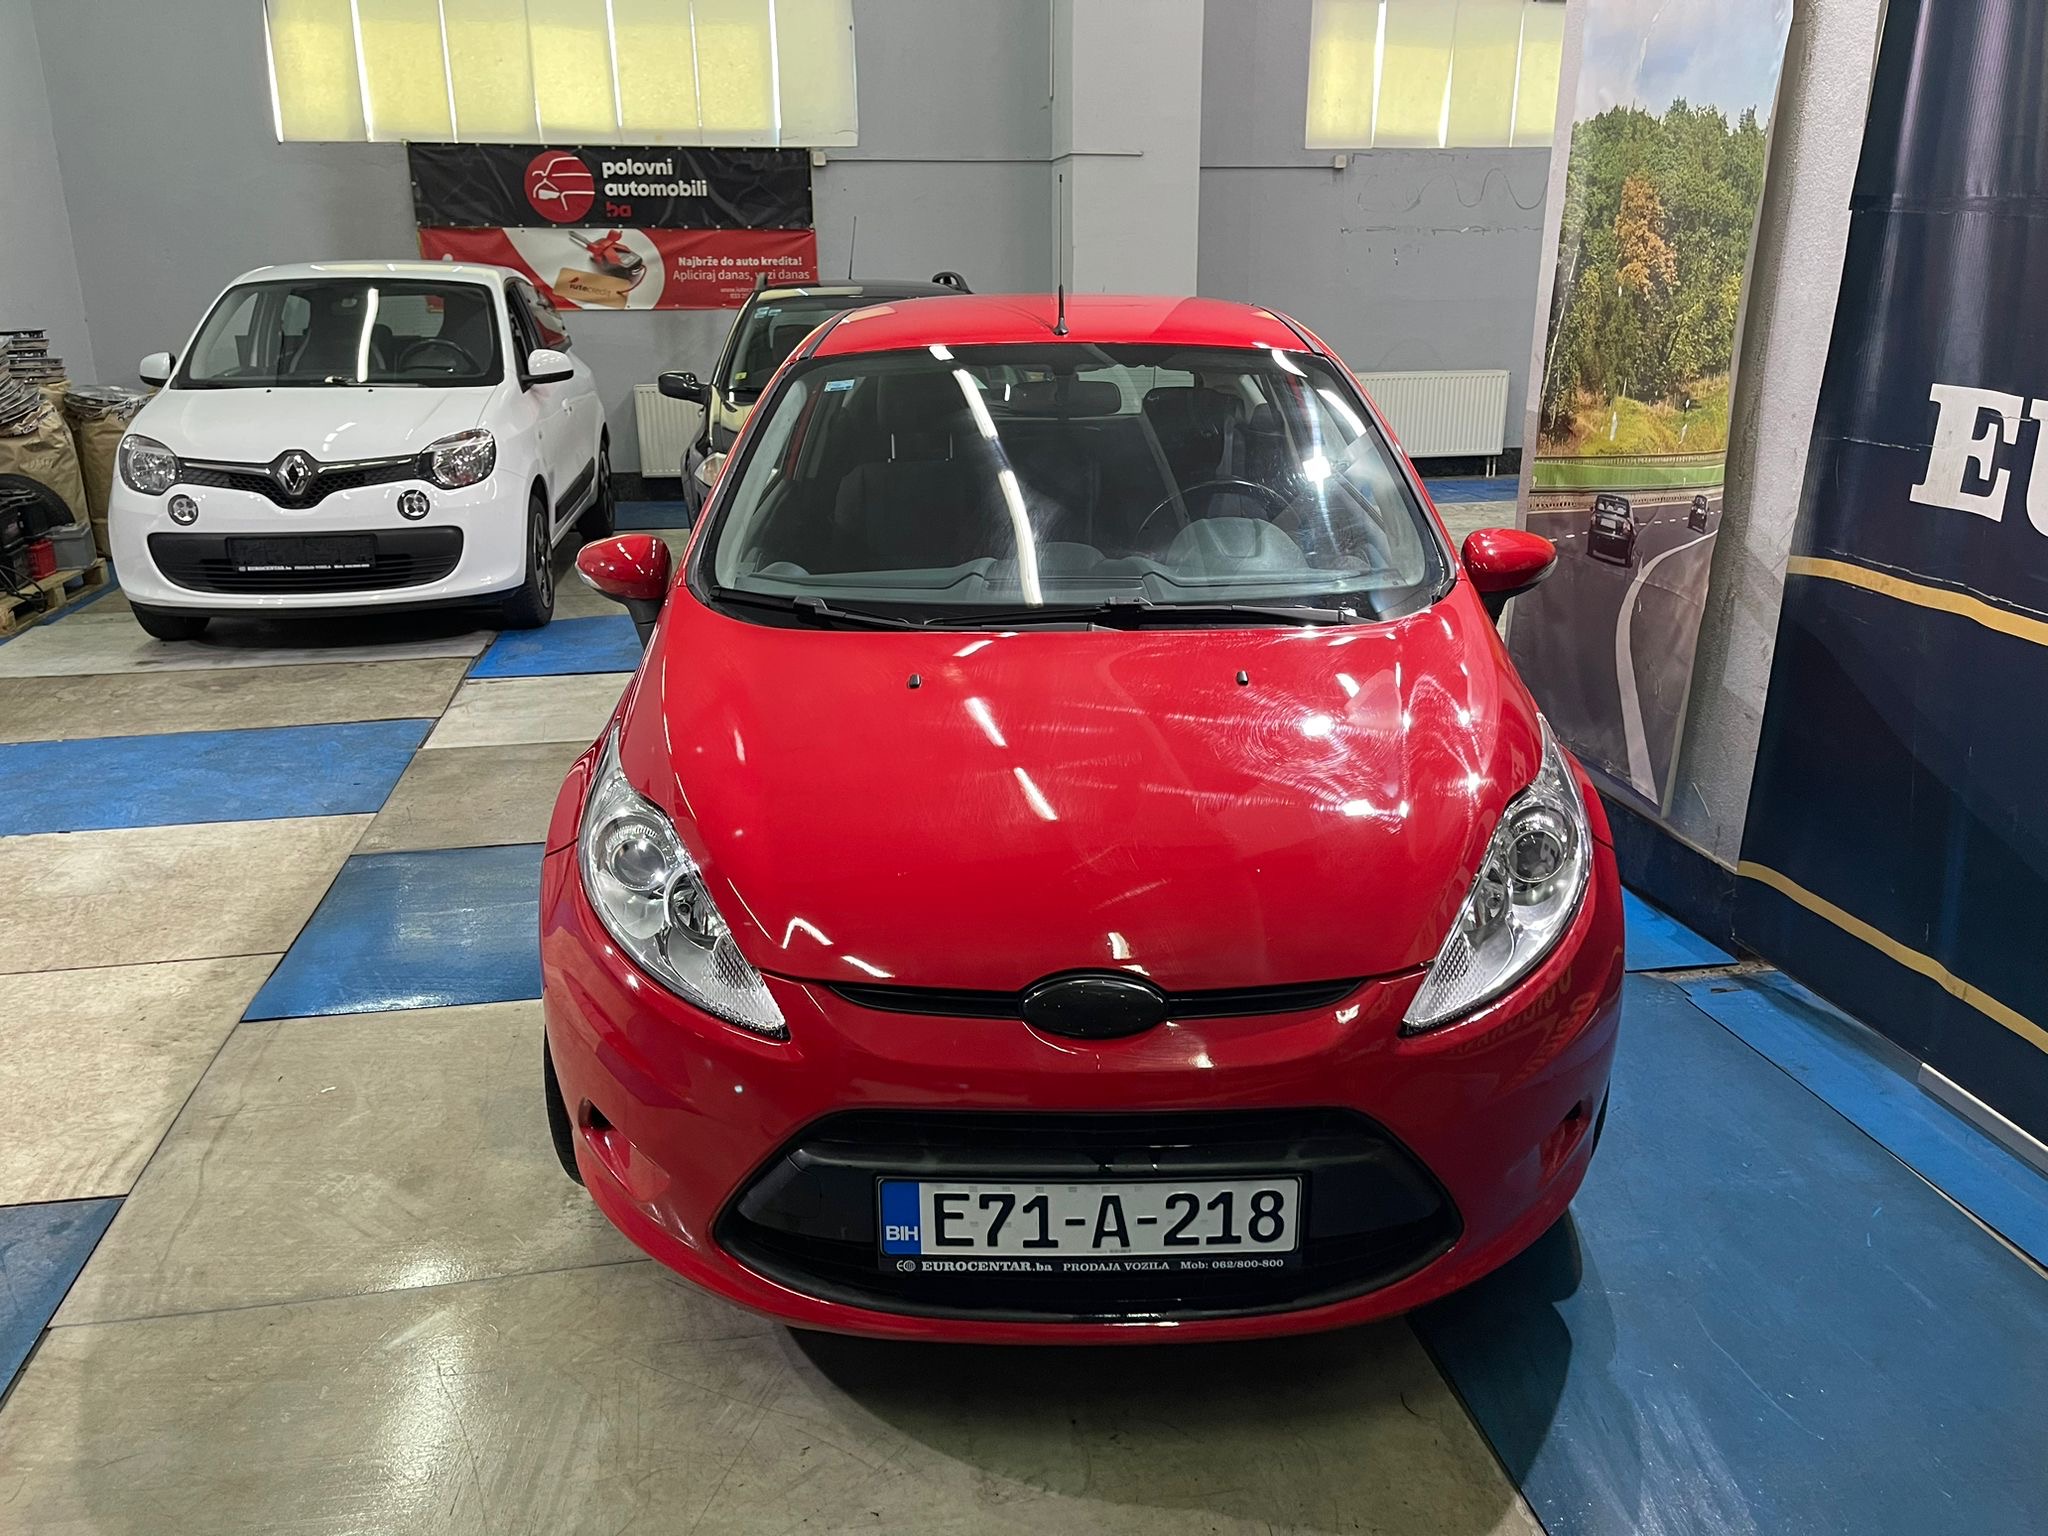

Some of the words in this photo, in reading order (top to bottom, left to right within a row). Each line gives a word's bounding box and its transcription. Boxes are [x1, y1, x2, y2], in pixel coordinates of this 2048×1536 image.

[602, 158, 673, 179] polovni
[604, 180, 708, 197] automobili
[678, 256, 718, 268] Najbrže
[720, 256, 734, 266] do
[736, 257, 760, 266] auto
[761, 256, 803, 266] kredita!
[673, 269, 716, 282] Apliciraj
[718, 269, 753, 281] danas,
[778, 268, 811, 280] danas
[1909, 383, 2048, 538] E
[933, 1189, 1286, 1249] E71-A-218
[885, 1225, 919, 1241] BIH
[921, 1260, 1053, 1272] EUROCENTAR.ba
[1063, 1261, 1122, 1272] PRODAJA
[1124, 1261, 1170, 1271] VOZILA
[1180, 1260, 1209, 1270] Mob:
[1211, 1259, 1284, 1270] 062/800-800
